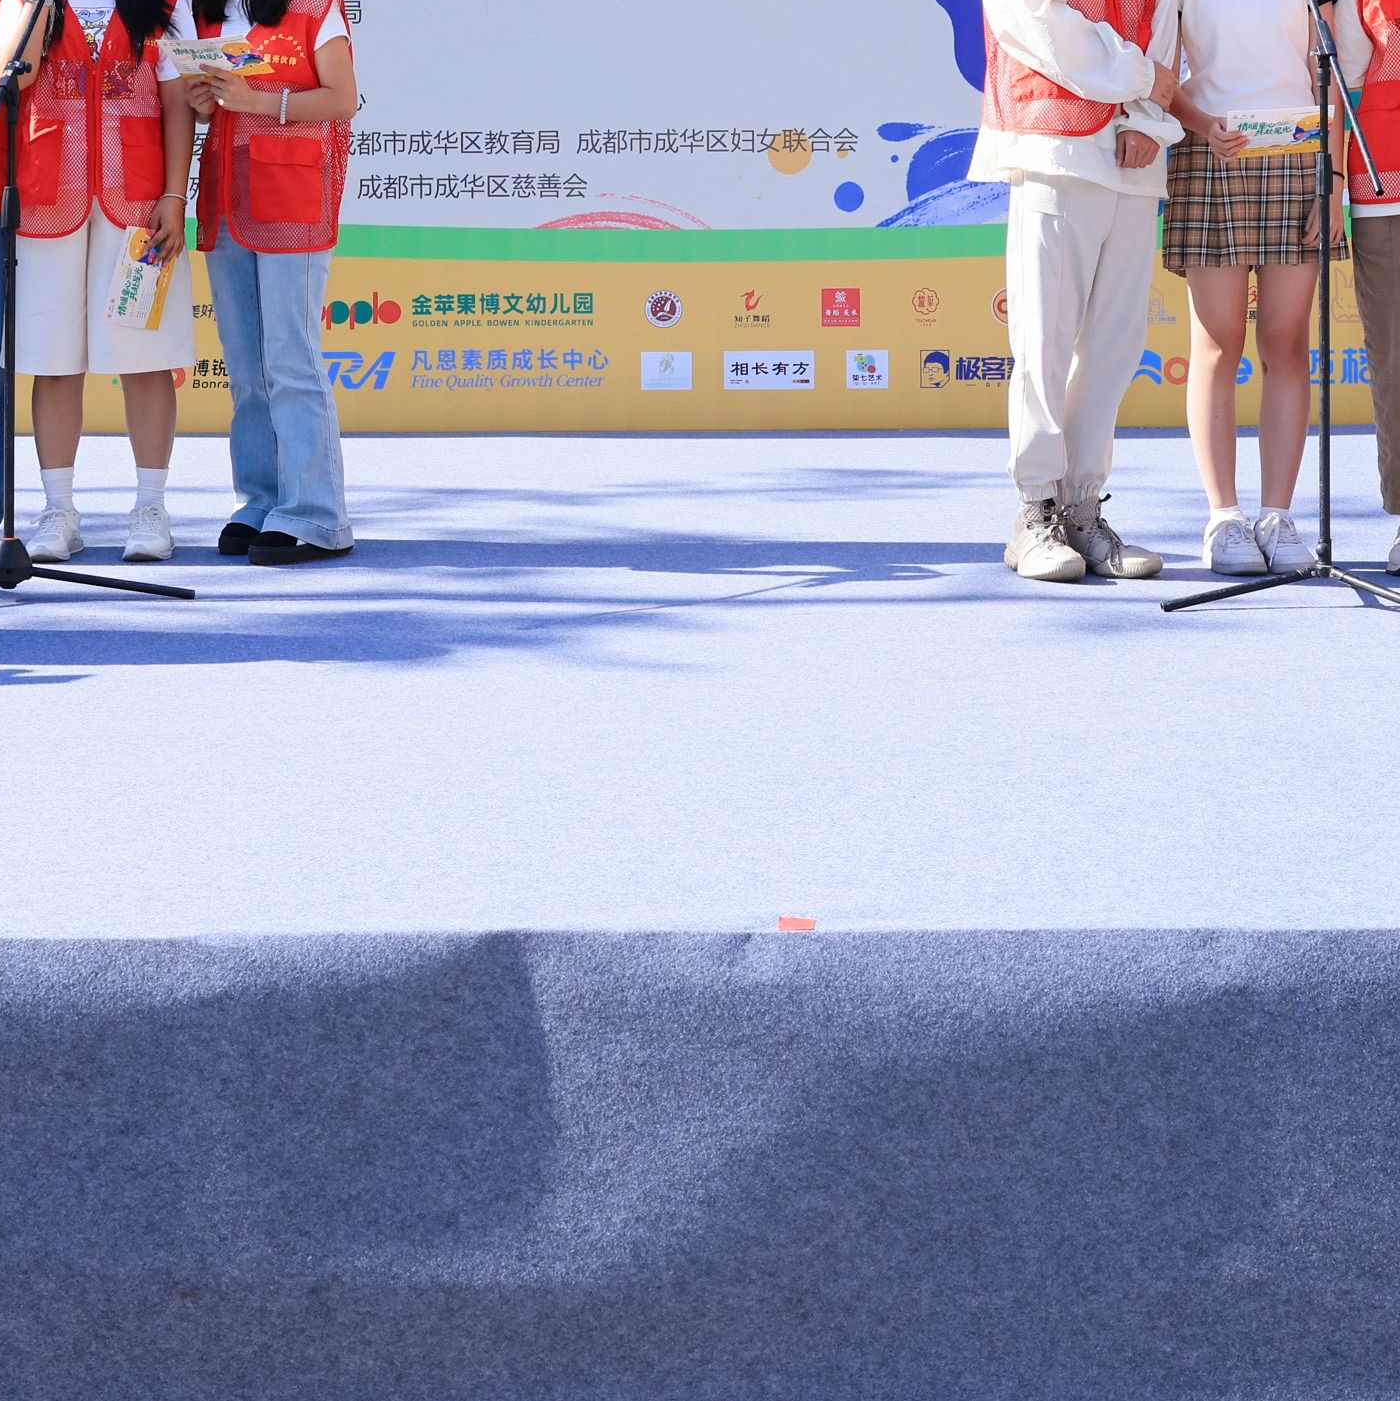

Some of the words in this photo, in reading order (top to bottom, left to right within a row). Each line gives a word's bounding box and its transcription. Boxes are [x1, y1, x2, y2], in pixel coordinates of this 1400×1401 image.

[576, 127, 859, 154] 成都市成华区妇女联合会
[357, 173, 588, 199] 成都市成华区慈善会
[412, 293, 593, 315] 金苹果博文幼儿园
[411, 349, 609, 371] 凡恩素质成长中心
[730, 362, 809, 376] 相长有方
[411, 375, 443, 388] Fine
[445, 374, 496, 391] Quality
[500, 374, 553, 388] Growth
[556, 373, 605, 387] Center
